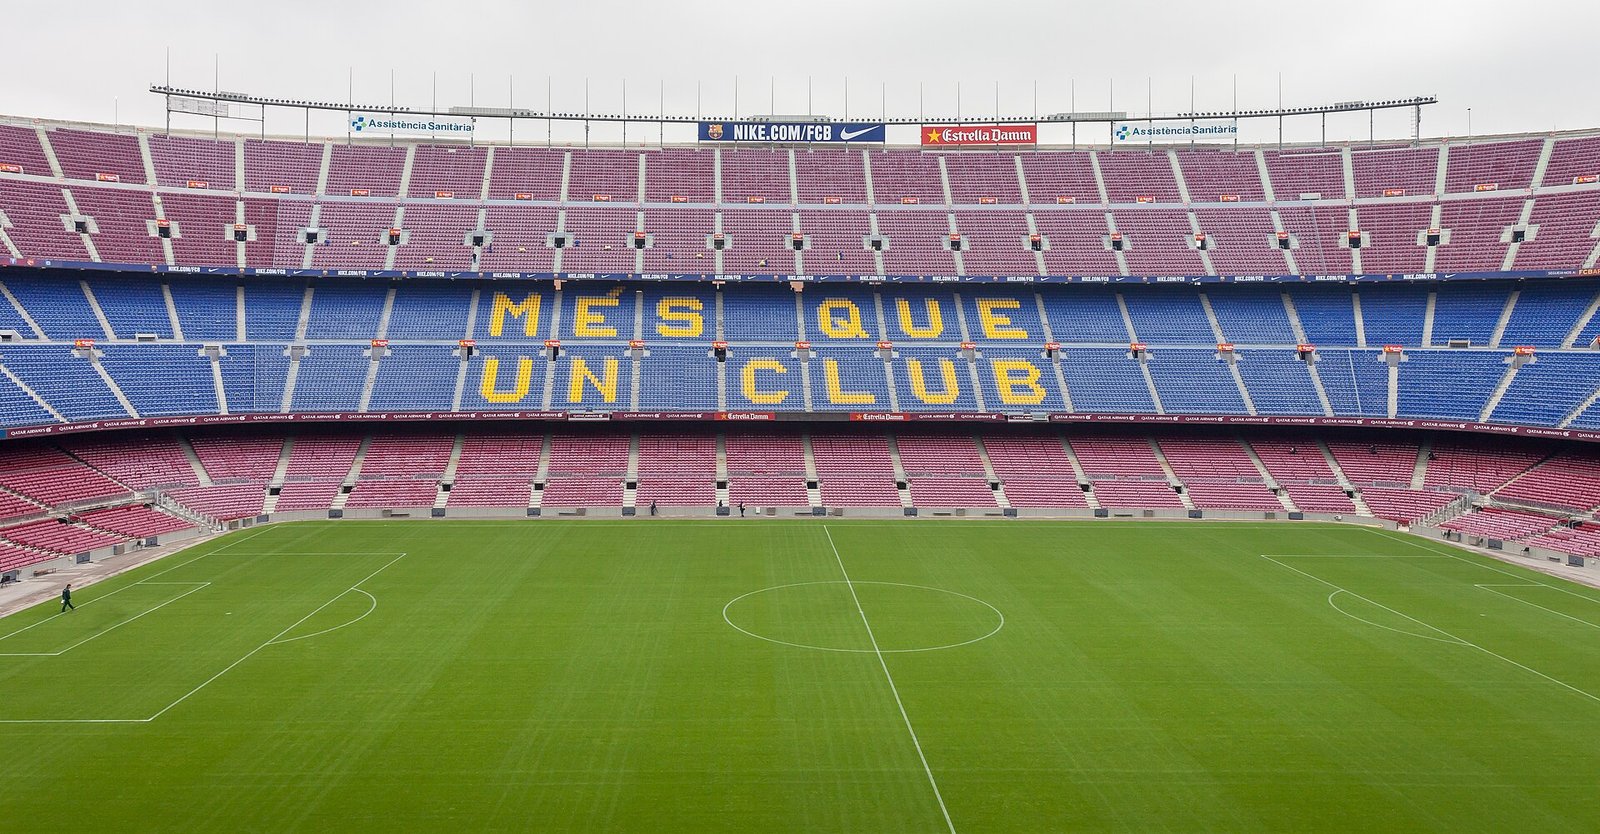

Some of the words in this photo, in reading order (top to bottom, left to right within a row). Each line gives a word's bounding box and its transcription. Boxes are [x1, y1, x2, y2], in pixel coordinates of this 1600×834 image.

[368, 118, 427, 130] Assistència
[428, 121, 472, 132] Sanitària
[733, 124, 832, 141] NIKE.COM/FCB
[1132, 126, 1190, 136] Assistència
[1192, 125, 1237, 135] Sanitària
[941, 128, 989, 142] Estrella
[990, 128, 1032, 142] Damm
[490, 286, 703, 337] MÉS
[817, 297, 1027, 339] QUE
[481, 358, 617, 404] UN
[740, 360, 1046, 405] CLUB
